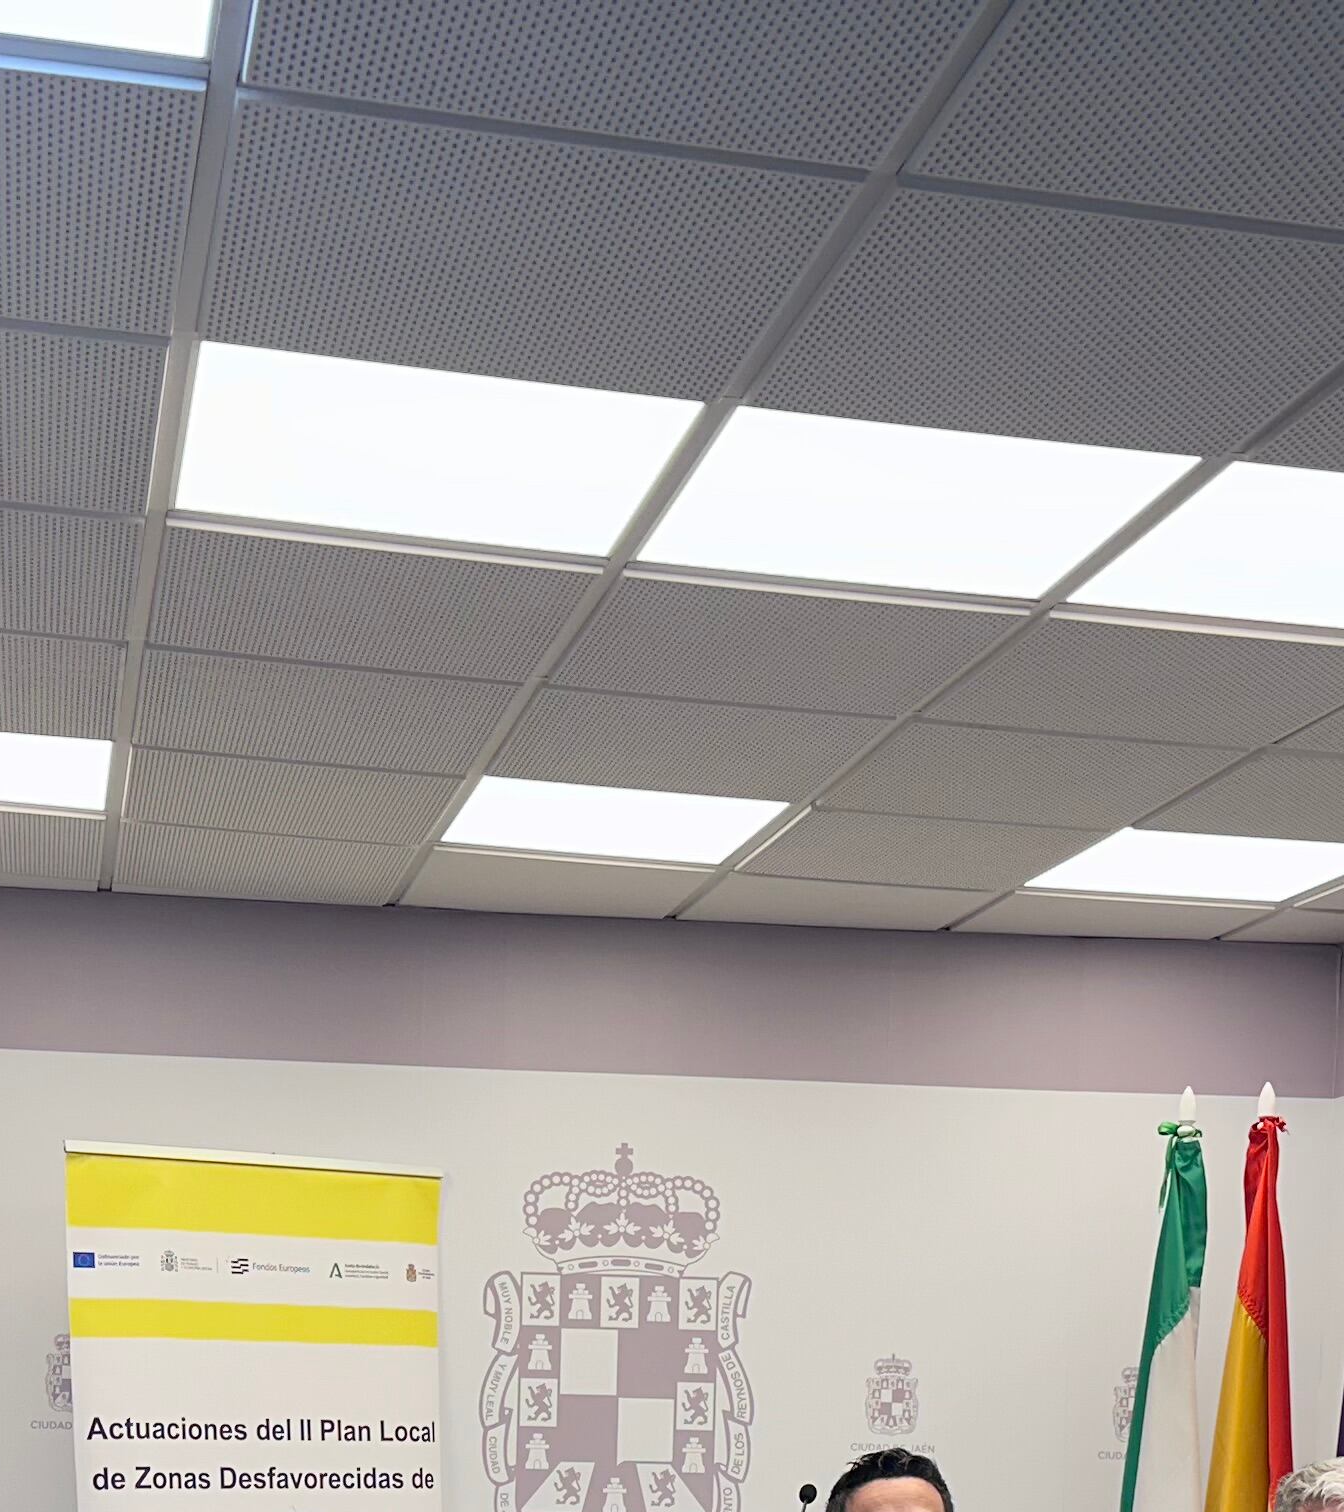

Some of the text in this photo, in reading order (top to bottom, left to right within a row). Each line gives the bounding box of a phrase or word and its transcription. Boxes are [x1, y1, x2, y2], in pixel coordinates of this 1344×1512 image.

[252, 1262, 311, 1274] Fondos Europeos
[498, 1281, 513, 1345] MUY NOBLE
[720, 1285, 736, 1341] CASTILLA
[721, 1352, 736, 1371] DE
[485, 1395, 497, 1421] LEAL
[730, 1371, 749, 1419] REYNOS
[30, 1420, 73, 1430] CIUDAD
[86, 1417, 436, 1444] Actuaciones del II Plan Local
[488, 1435, 501, 1474] CIUDAD
[731, 1433, 745, 1475] DE LOS
[1097, 1451, 1124, 1460] CIUD
[92, 1466, 435, 1491] de Zonas Desfavorecidas de
[499, 1492, 510, 1508] DE
